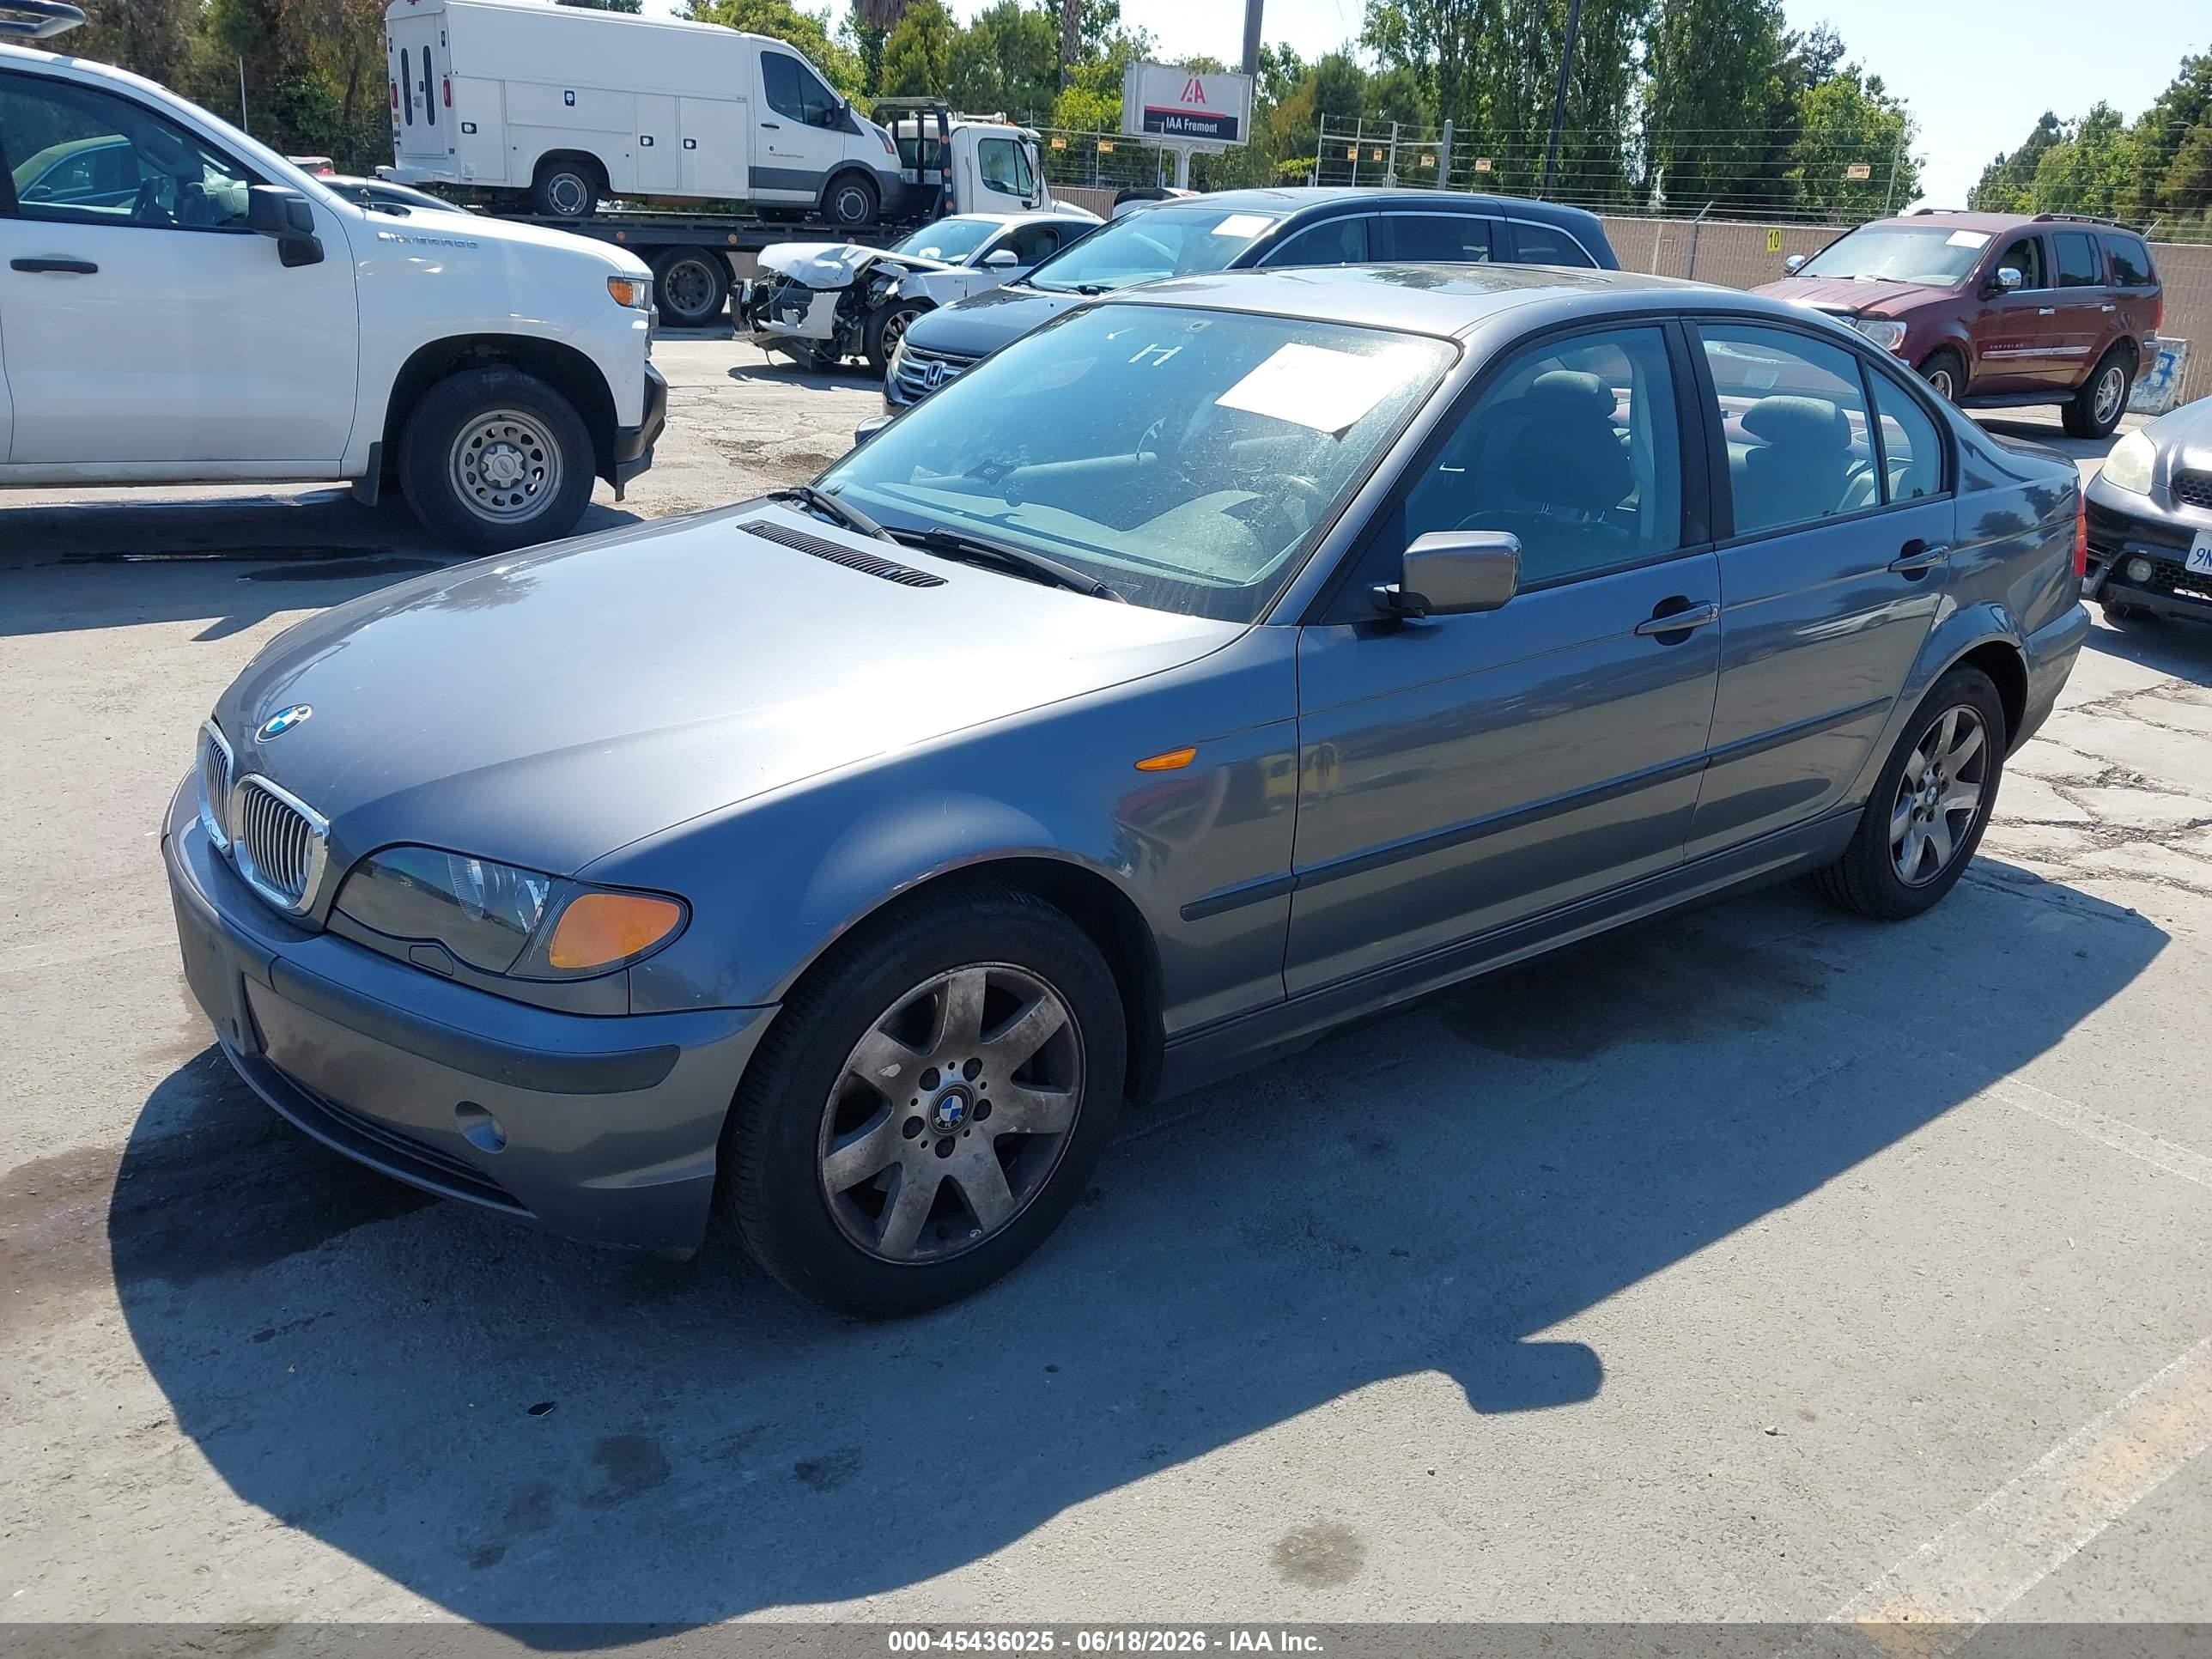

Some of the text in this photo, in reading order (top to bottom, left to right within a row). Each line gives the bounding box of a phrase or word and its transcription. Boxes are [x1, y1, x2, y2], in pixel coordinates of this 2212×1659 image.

[1166, 116, 1218, 134] IAA Fremont
[1769, 231, 1779, 248] 10
